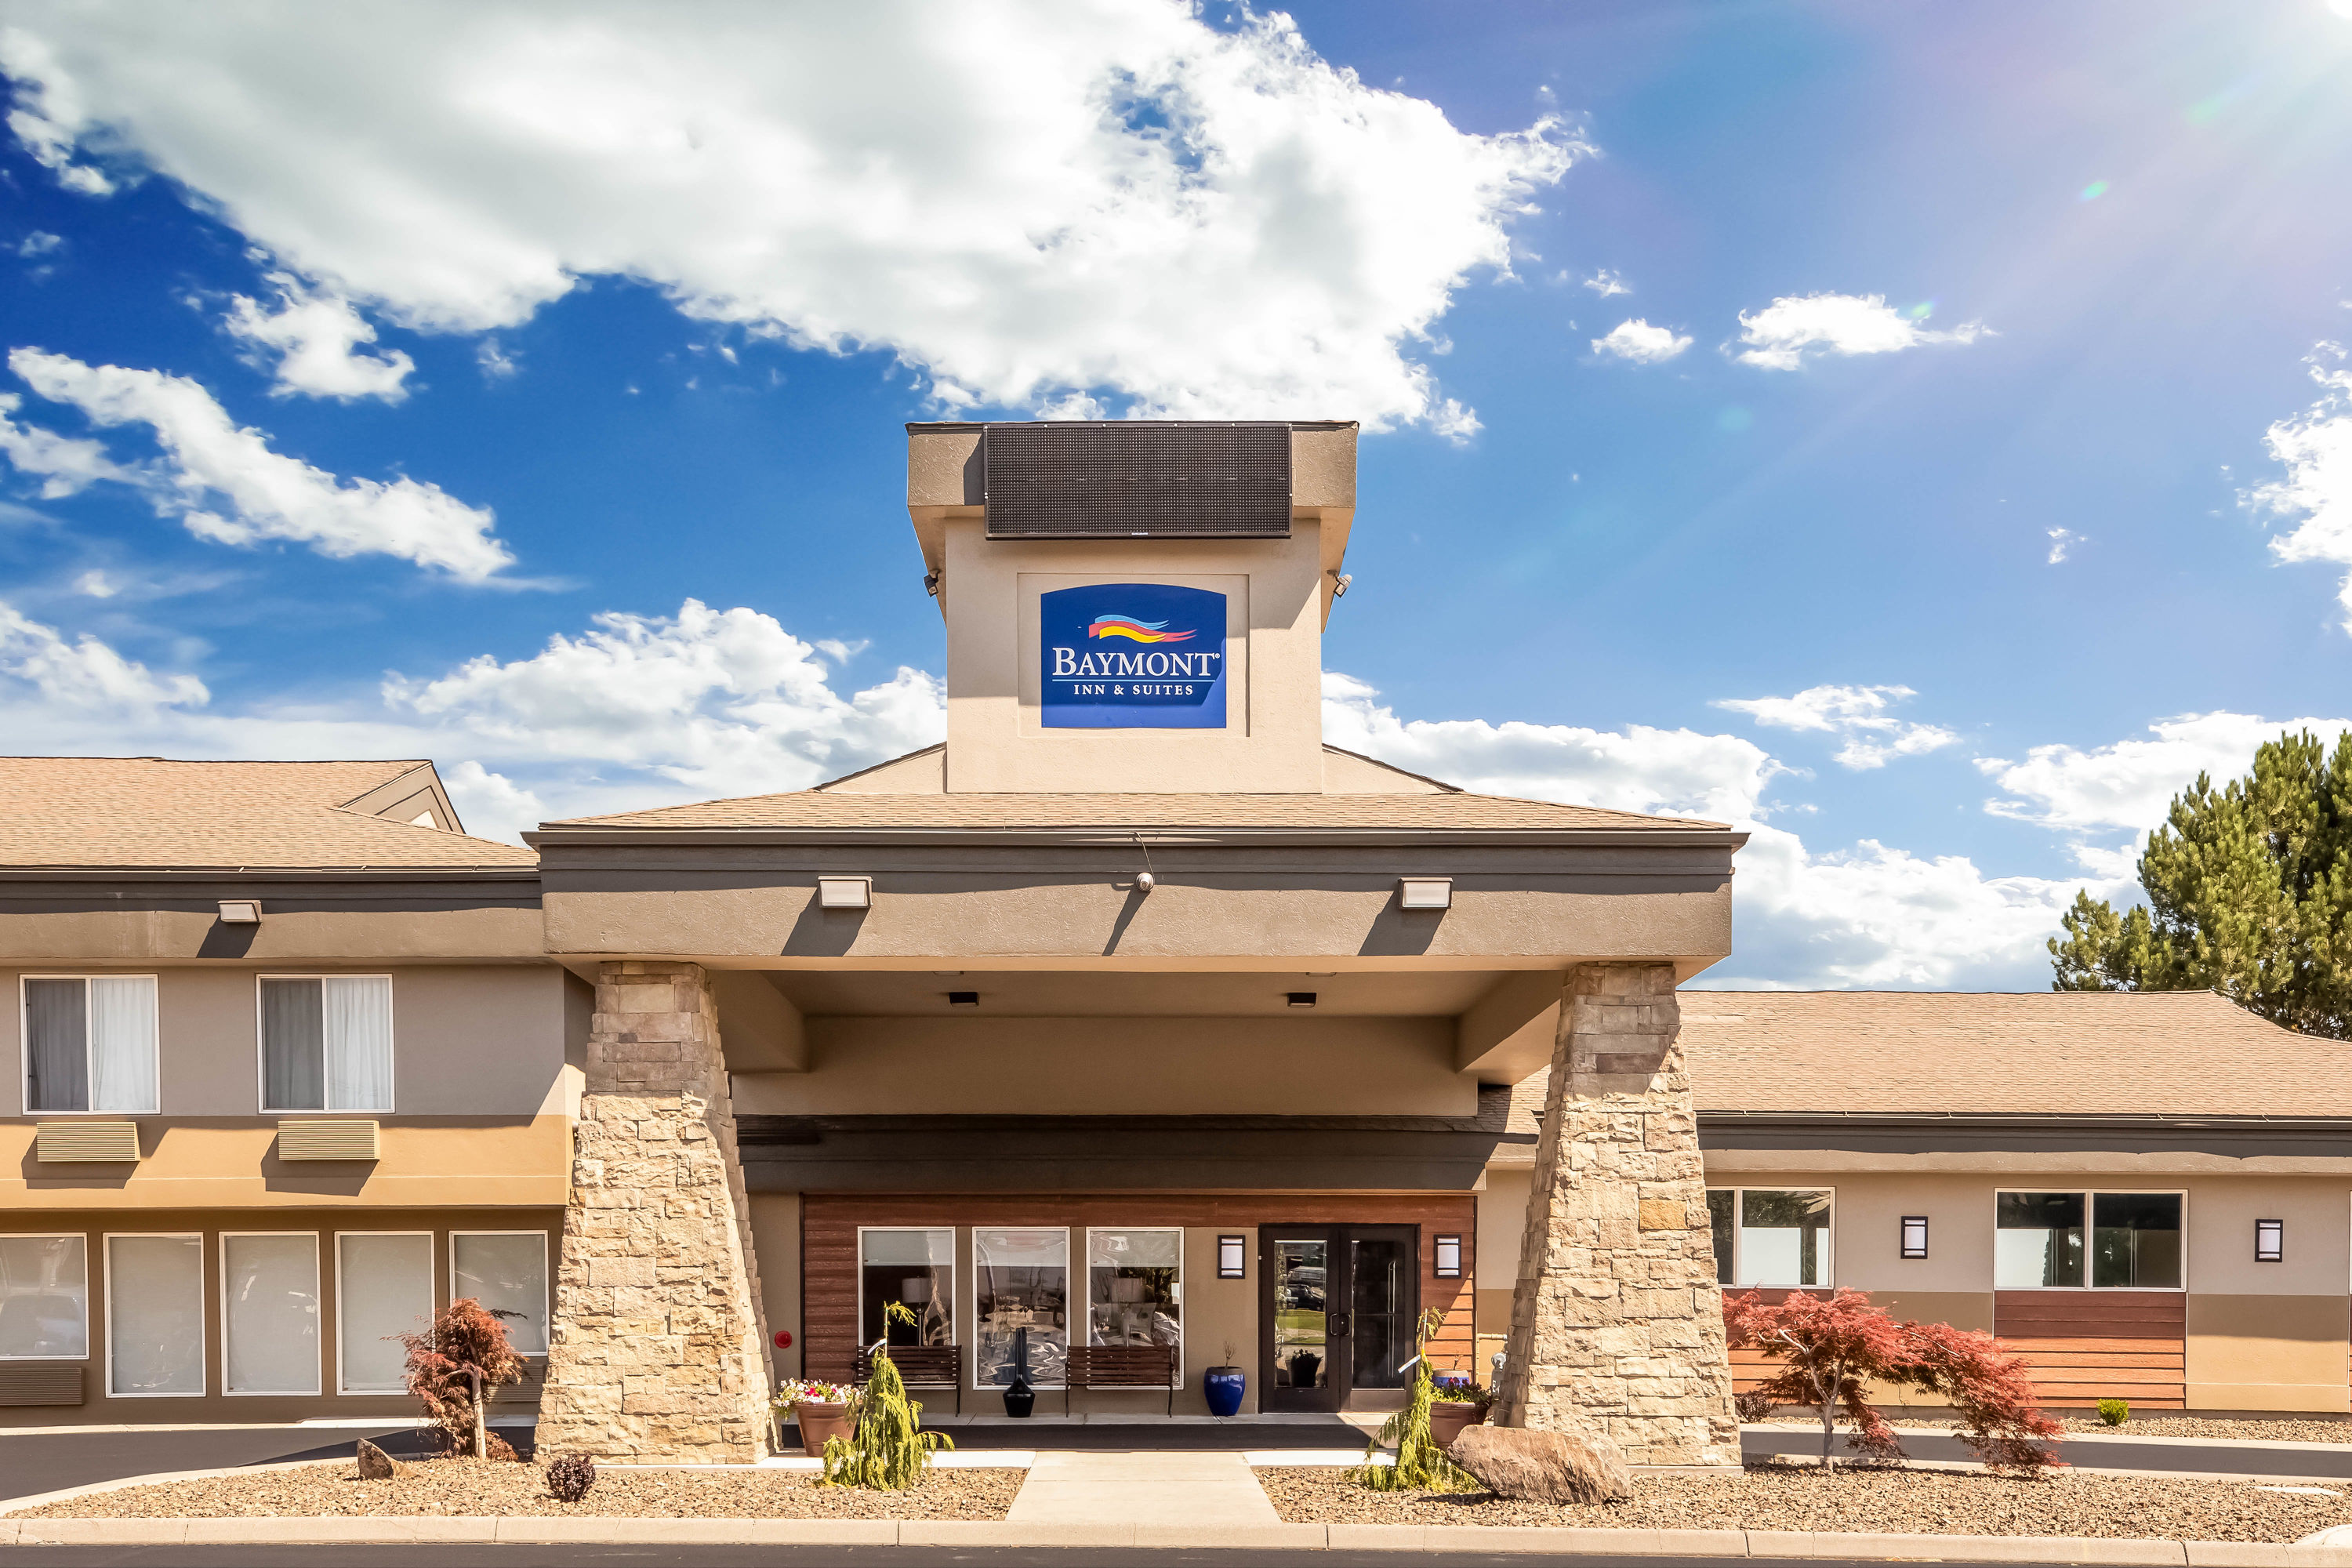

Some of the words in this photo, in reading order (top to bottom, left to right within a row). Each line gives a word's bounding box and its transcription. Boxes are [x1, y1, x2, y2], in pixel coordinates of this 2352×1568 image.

[1073, 684, 1105, 695] INN
[1113, 684, 1124, 695] &
[1132, 684, 1193, 695] SUITES
